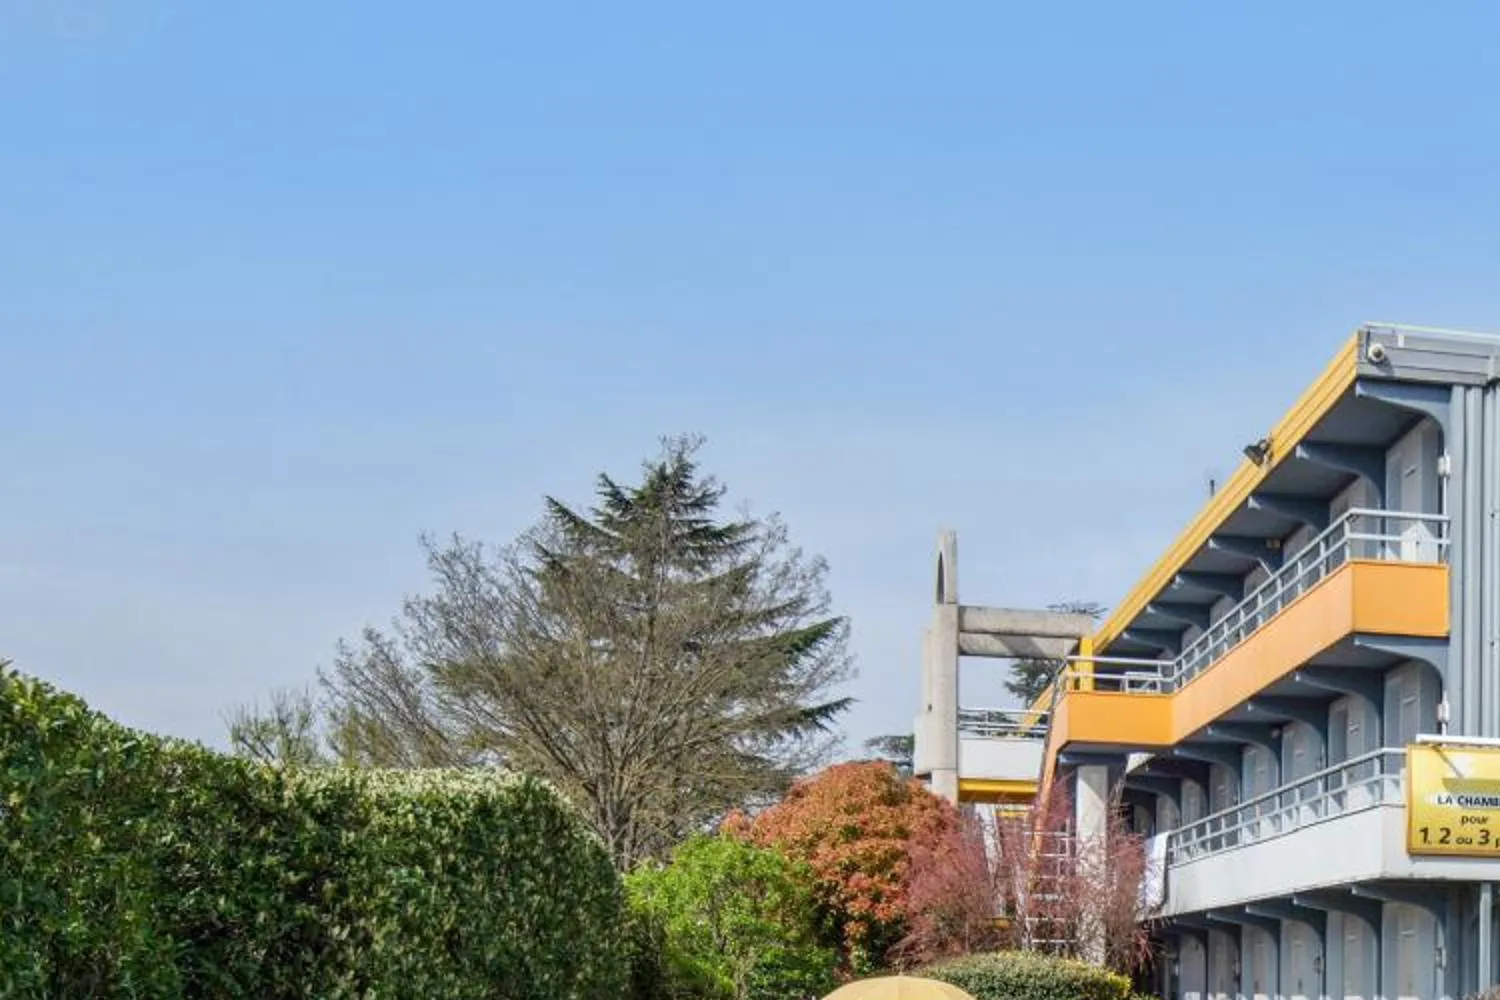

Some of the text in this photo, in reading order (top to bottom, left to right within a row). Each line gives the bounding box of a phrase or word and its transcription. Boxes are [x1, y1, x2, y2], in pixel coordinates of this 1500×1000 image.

[1437, 795, 1453, 805] LA
[1460, 815, 1489, 825] pour
[1438, 827, 1451, 845] 2
[1455, 836, 1473, 845] ou
[1477, 829, 1491, 845] 3
